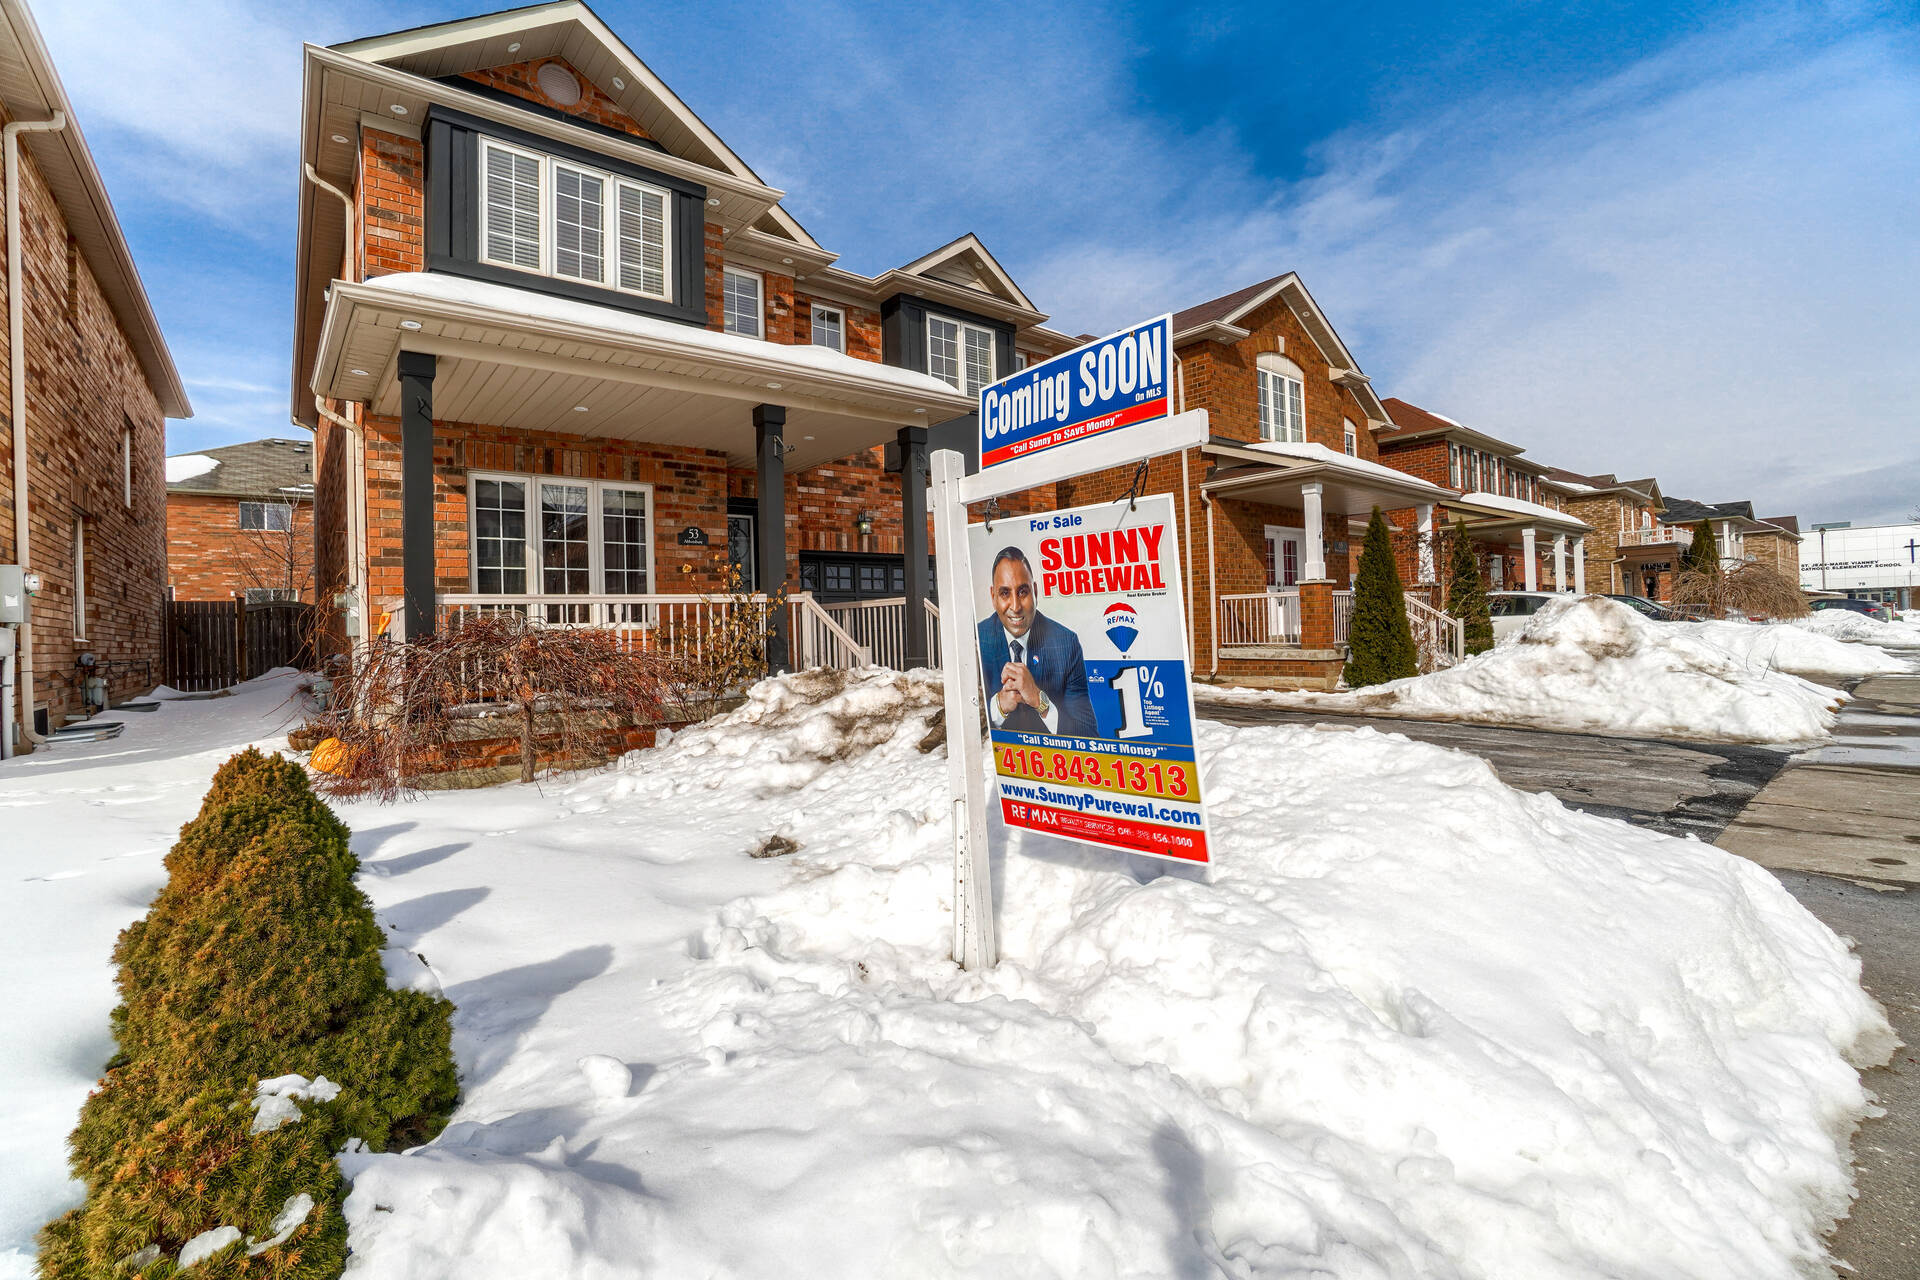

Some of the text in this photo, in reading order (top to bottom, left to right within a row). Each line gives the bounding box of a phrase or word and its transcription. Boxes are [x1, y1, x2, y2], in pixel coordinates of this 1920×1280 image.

[984, 325, 1162, 440] Coming SOON
[1135, 386, 1162, 402] On MLS
[1029, 436, 1052, 450] Sunny
[1053, 432, 1062, 442] To
[1030, 514, 1083, 532] For Sale
[689, 529, 699, 539] 53
[1039, 524, 1165, 571] SUNNY
[1042, 562, 1166, 597] PUREWAL
[1106, 615, 1135, 626] RE/MAX
[1043, 737, 1072, 750] Sunny
[1074, 739, 1086, 750] To
[1002, 747, 1189, 797] 416.843.1313
[1001, 783, 1200, 826] www.SunnyPurewal.com
[1011, 804, 1059, 825] RE/MAX
